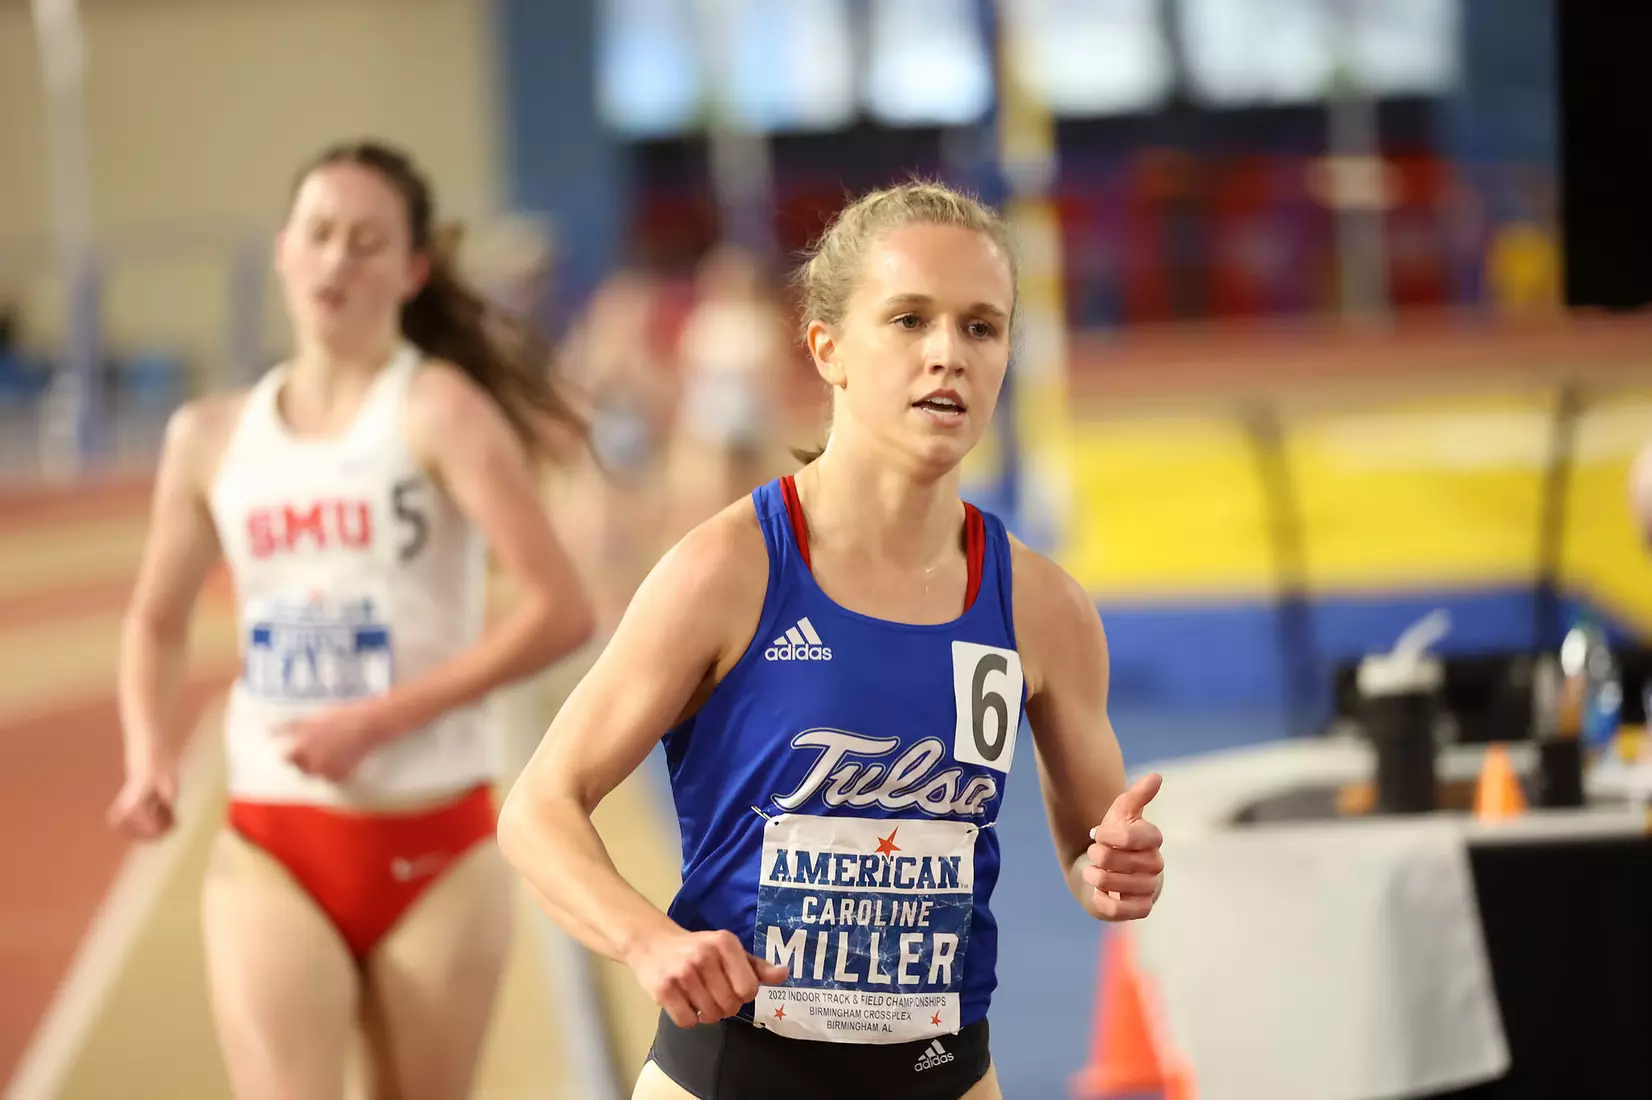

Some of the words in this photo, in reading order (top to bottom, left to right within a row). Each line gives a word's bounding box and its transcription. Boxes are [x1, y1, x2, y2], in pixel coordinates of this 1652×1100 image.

[247, 499, 373, 558] SMU
[391, 478, 431, 561] 5
[765, 644, 832, 661] adidas
[972, 653, 1008, 761] 6
[771, 727, 997, 818] Tulsa
[769, 849, 961, 889] AMERICAN
[801, 896, 934, 927] CAROLINE
[765, 925, 959, 985] MILLER
[768, 990, 786, 1000] 2022
[788, 991, 820, 1002] INDOOR
[822, 993, 850, 1004] TRACK
[853, 995, 858, 1004] &
[861, 995, 883, 1006] FIELD
[809, 1006, 861, 1018] BIRMINGHAM
[863, 1010, 912, 1021] CROSSPLEX
[881, 1023, 892, 1032] AL
[914, 1051, 954, 1072] adidas
